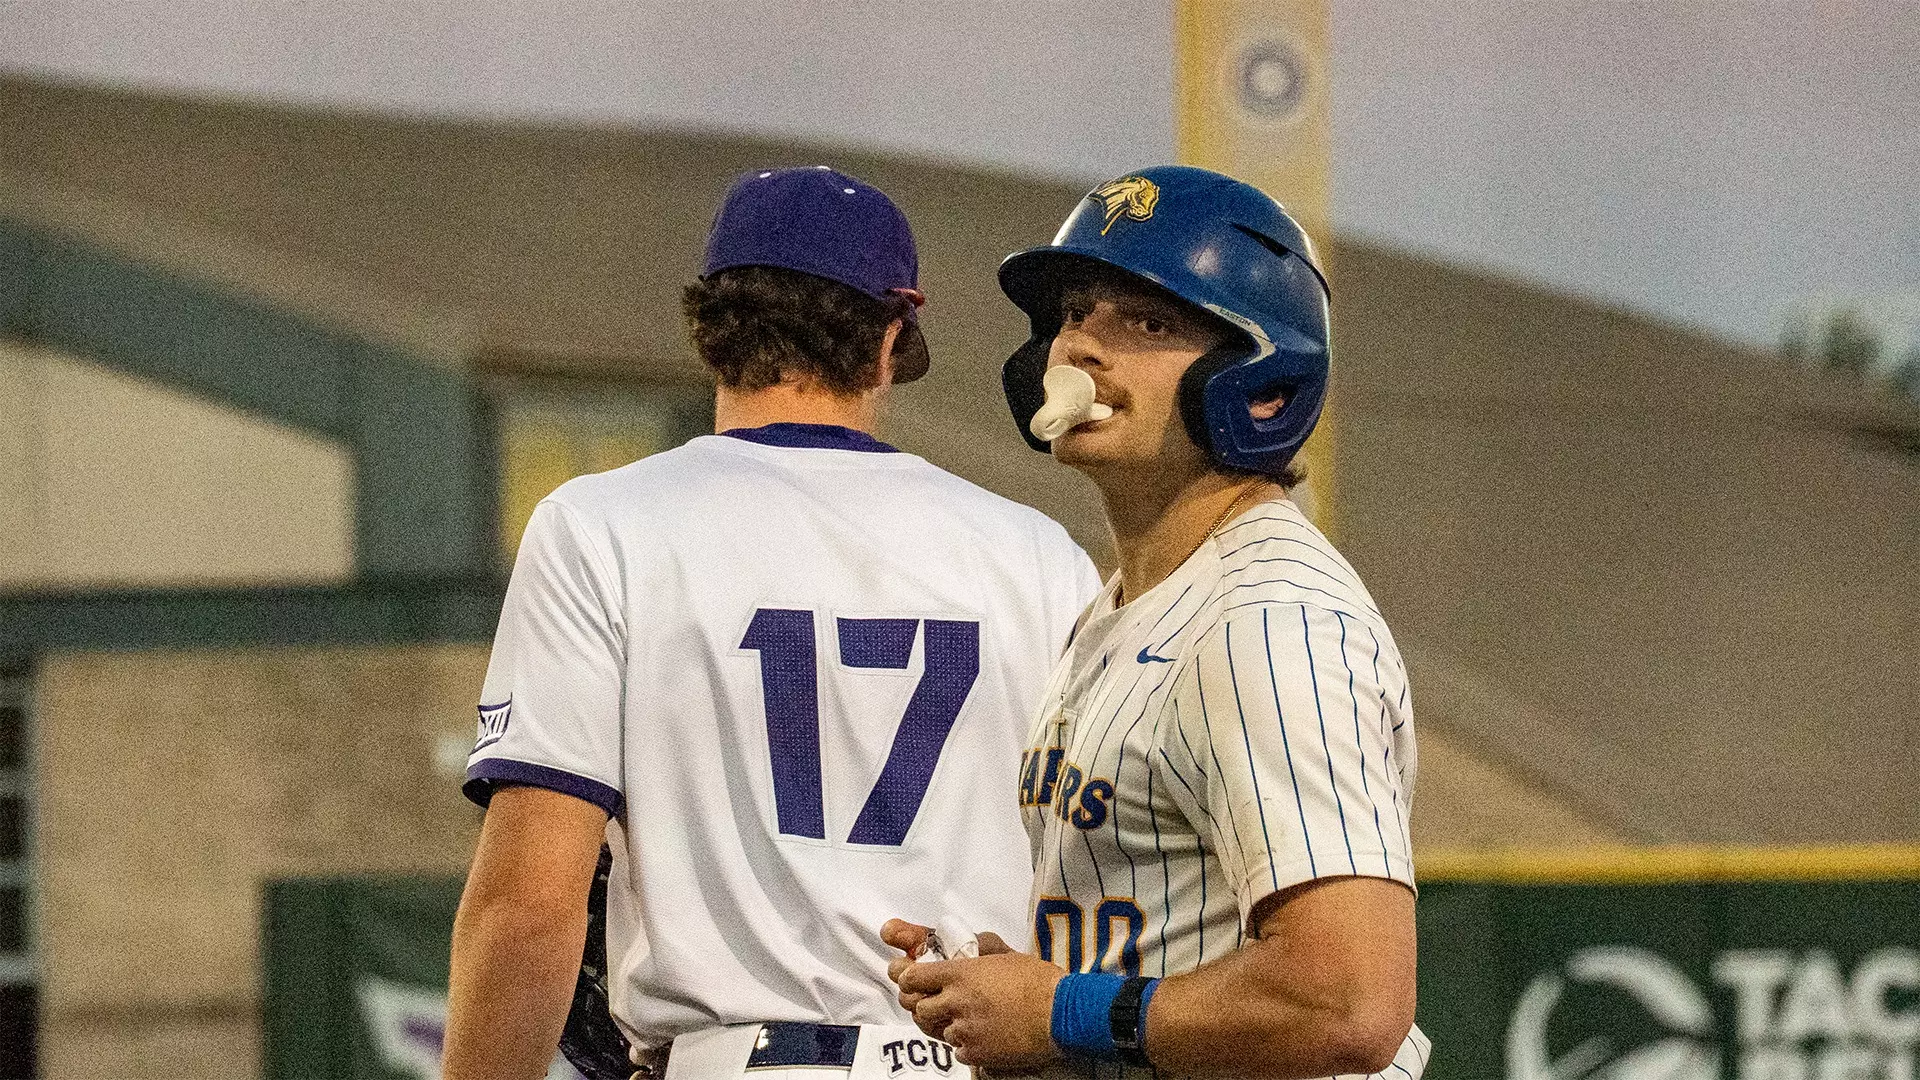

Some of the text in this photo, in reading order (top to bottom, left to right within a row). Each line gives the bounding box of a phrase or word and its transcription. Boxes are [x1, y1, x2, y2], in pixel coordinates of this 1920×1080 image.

[1219, 307, 1252, 327] EASTON
[738, 608, 980, 847] 17
[881, 1038, 954, 1076] TCU
